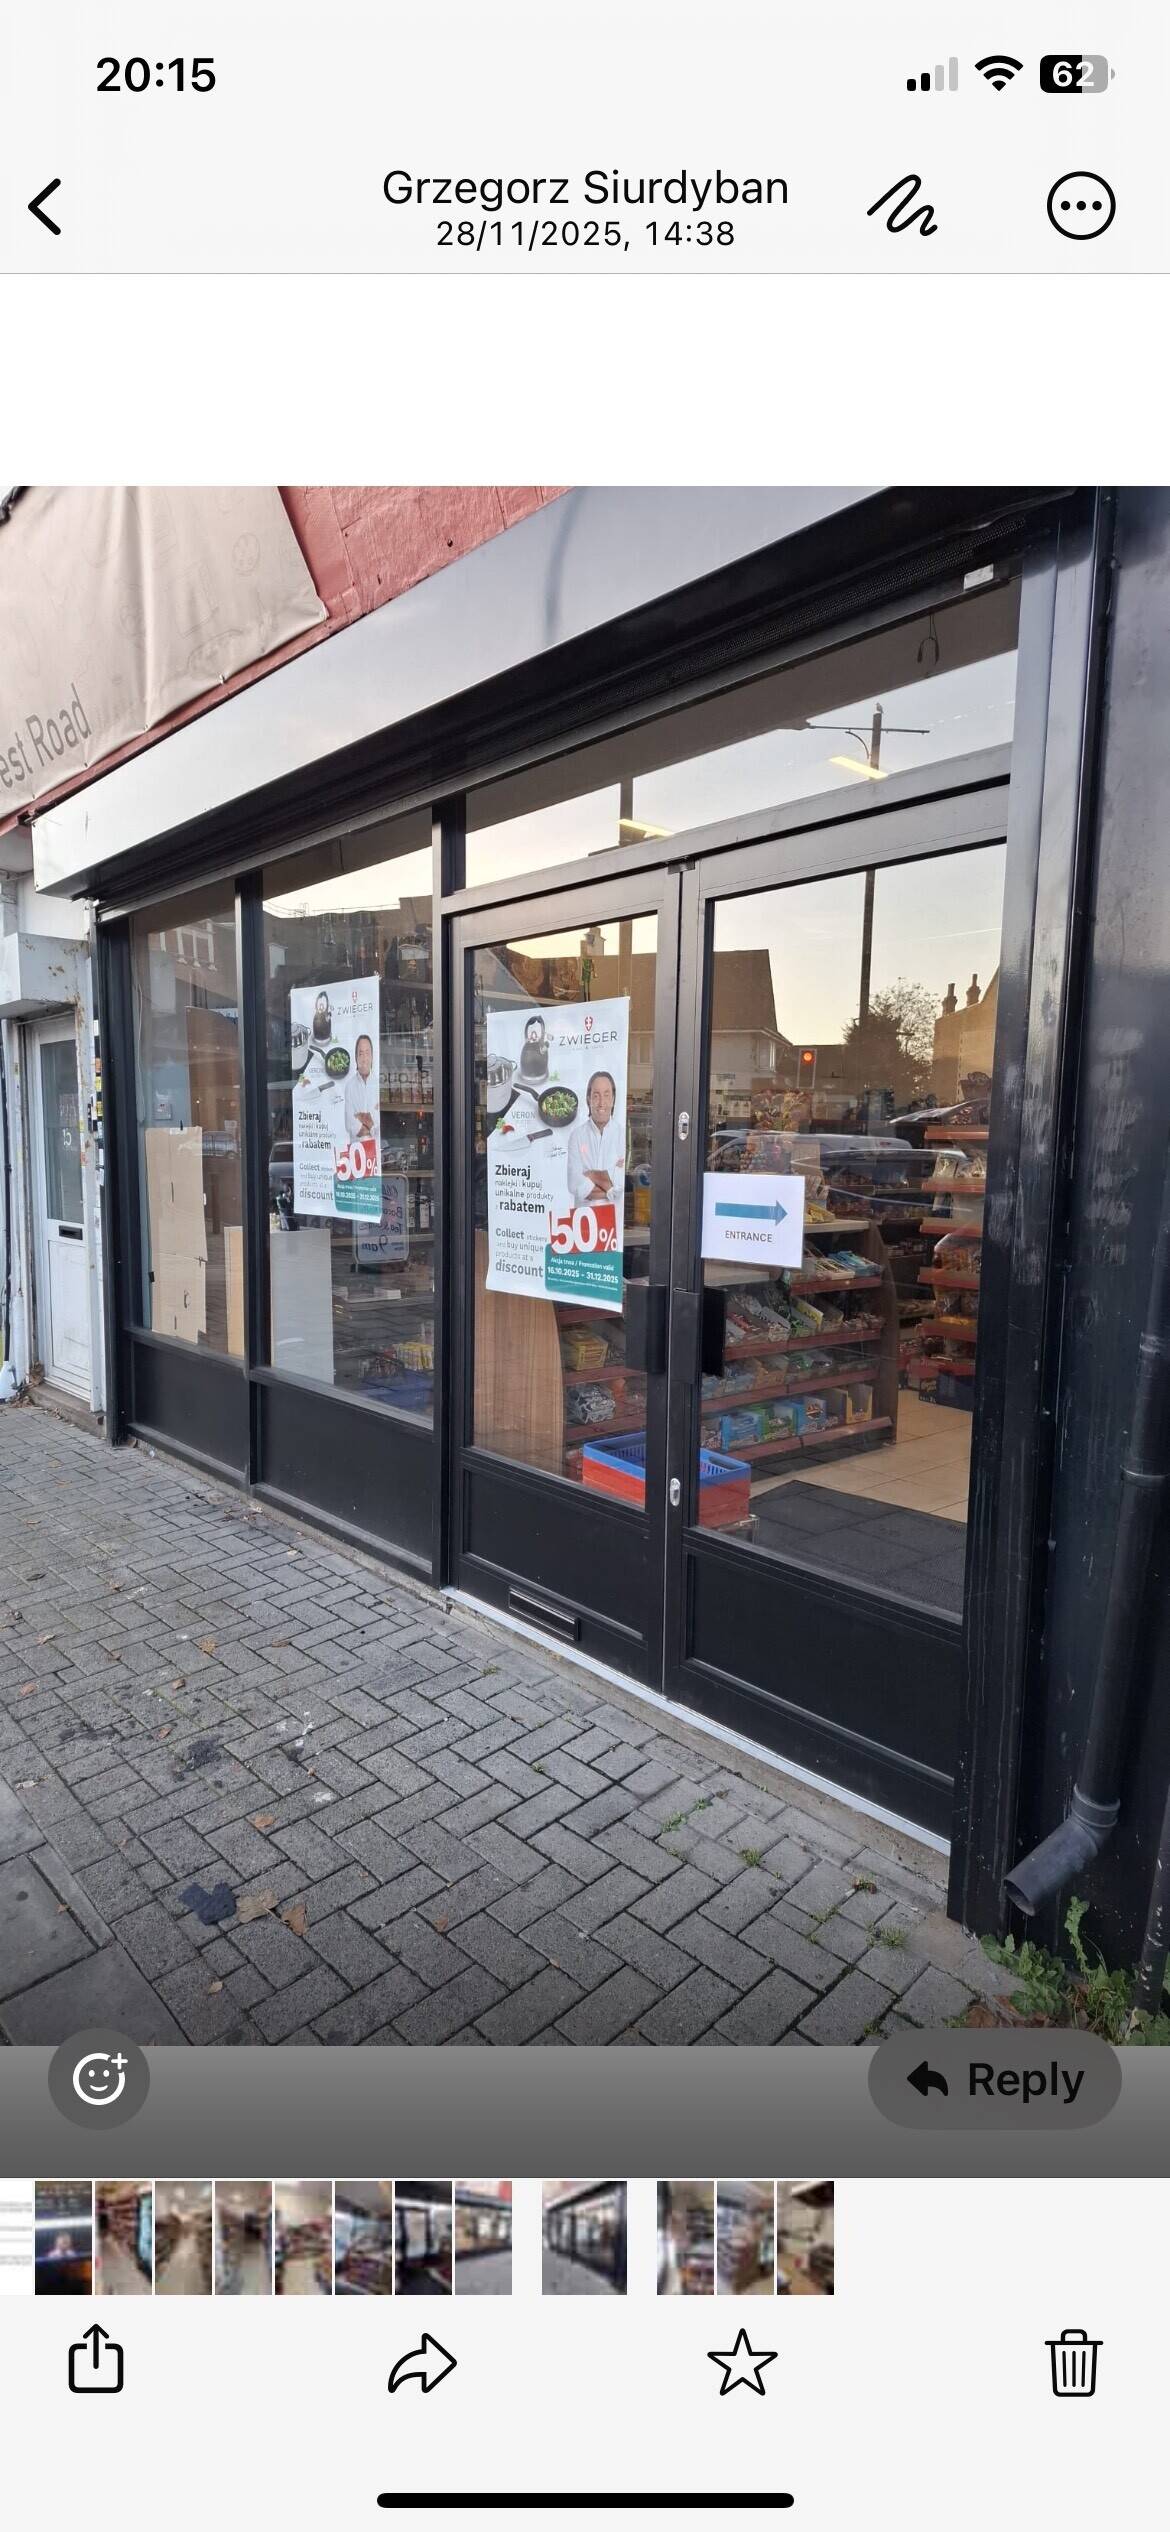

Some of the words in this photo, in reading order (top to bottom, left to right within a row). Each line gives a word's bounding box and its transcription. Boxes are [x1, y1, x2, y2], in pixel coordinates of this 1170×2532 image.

[25, 682, 93, 767] Road
[337, 1003, 373, 1015] ZWIEGER
[559, 1031, 618, 1046] ZWIEGER
[298, 1111, 322, 1123] Zbieraj
[336, 1141, 378, 1181] 50%
[495, 1164, 531, 1180] Zbieraj
[522, 1180, 543, 1190] kupuj
[299, 1188, 334, 1201] discount
[495, 1189, 525, 1198] unikalne
[526, 1191, 554, 1202] produkty
[499, 1199, 545, 1214] rabatem
[495, 1227, 525, 1239] Collect
[550, 1206, 618, 1254] 50%
[725, 1230, 773, 1243] ENTRANCE
[506, 1240, 519, 1250] buy
[519, 1242, 544, 1252] unique
[495, 1259, 544, 1277] discount
[586, 1271, 619, 1284] 31.12.2025
